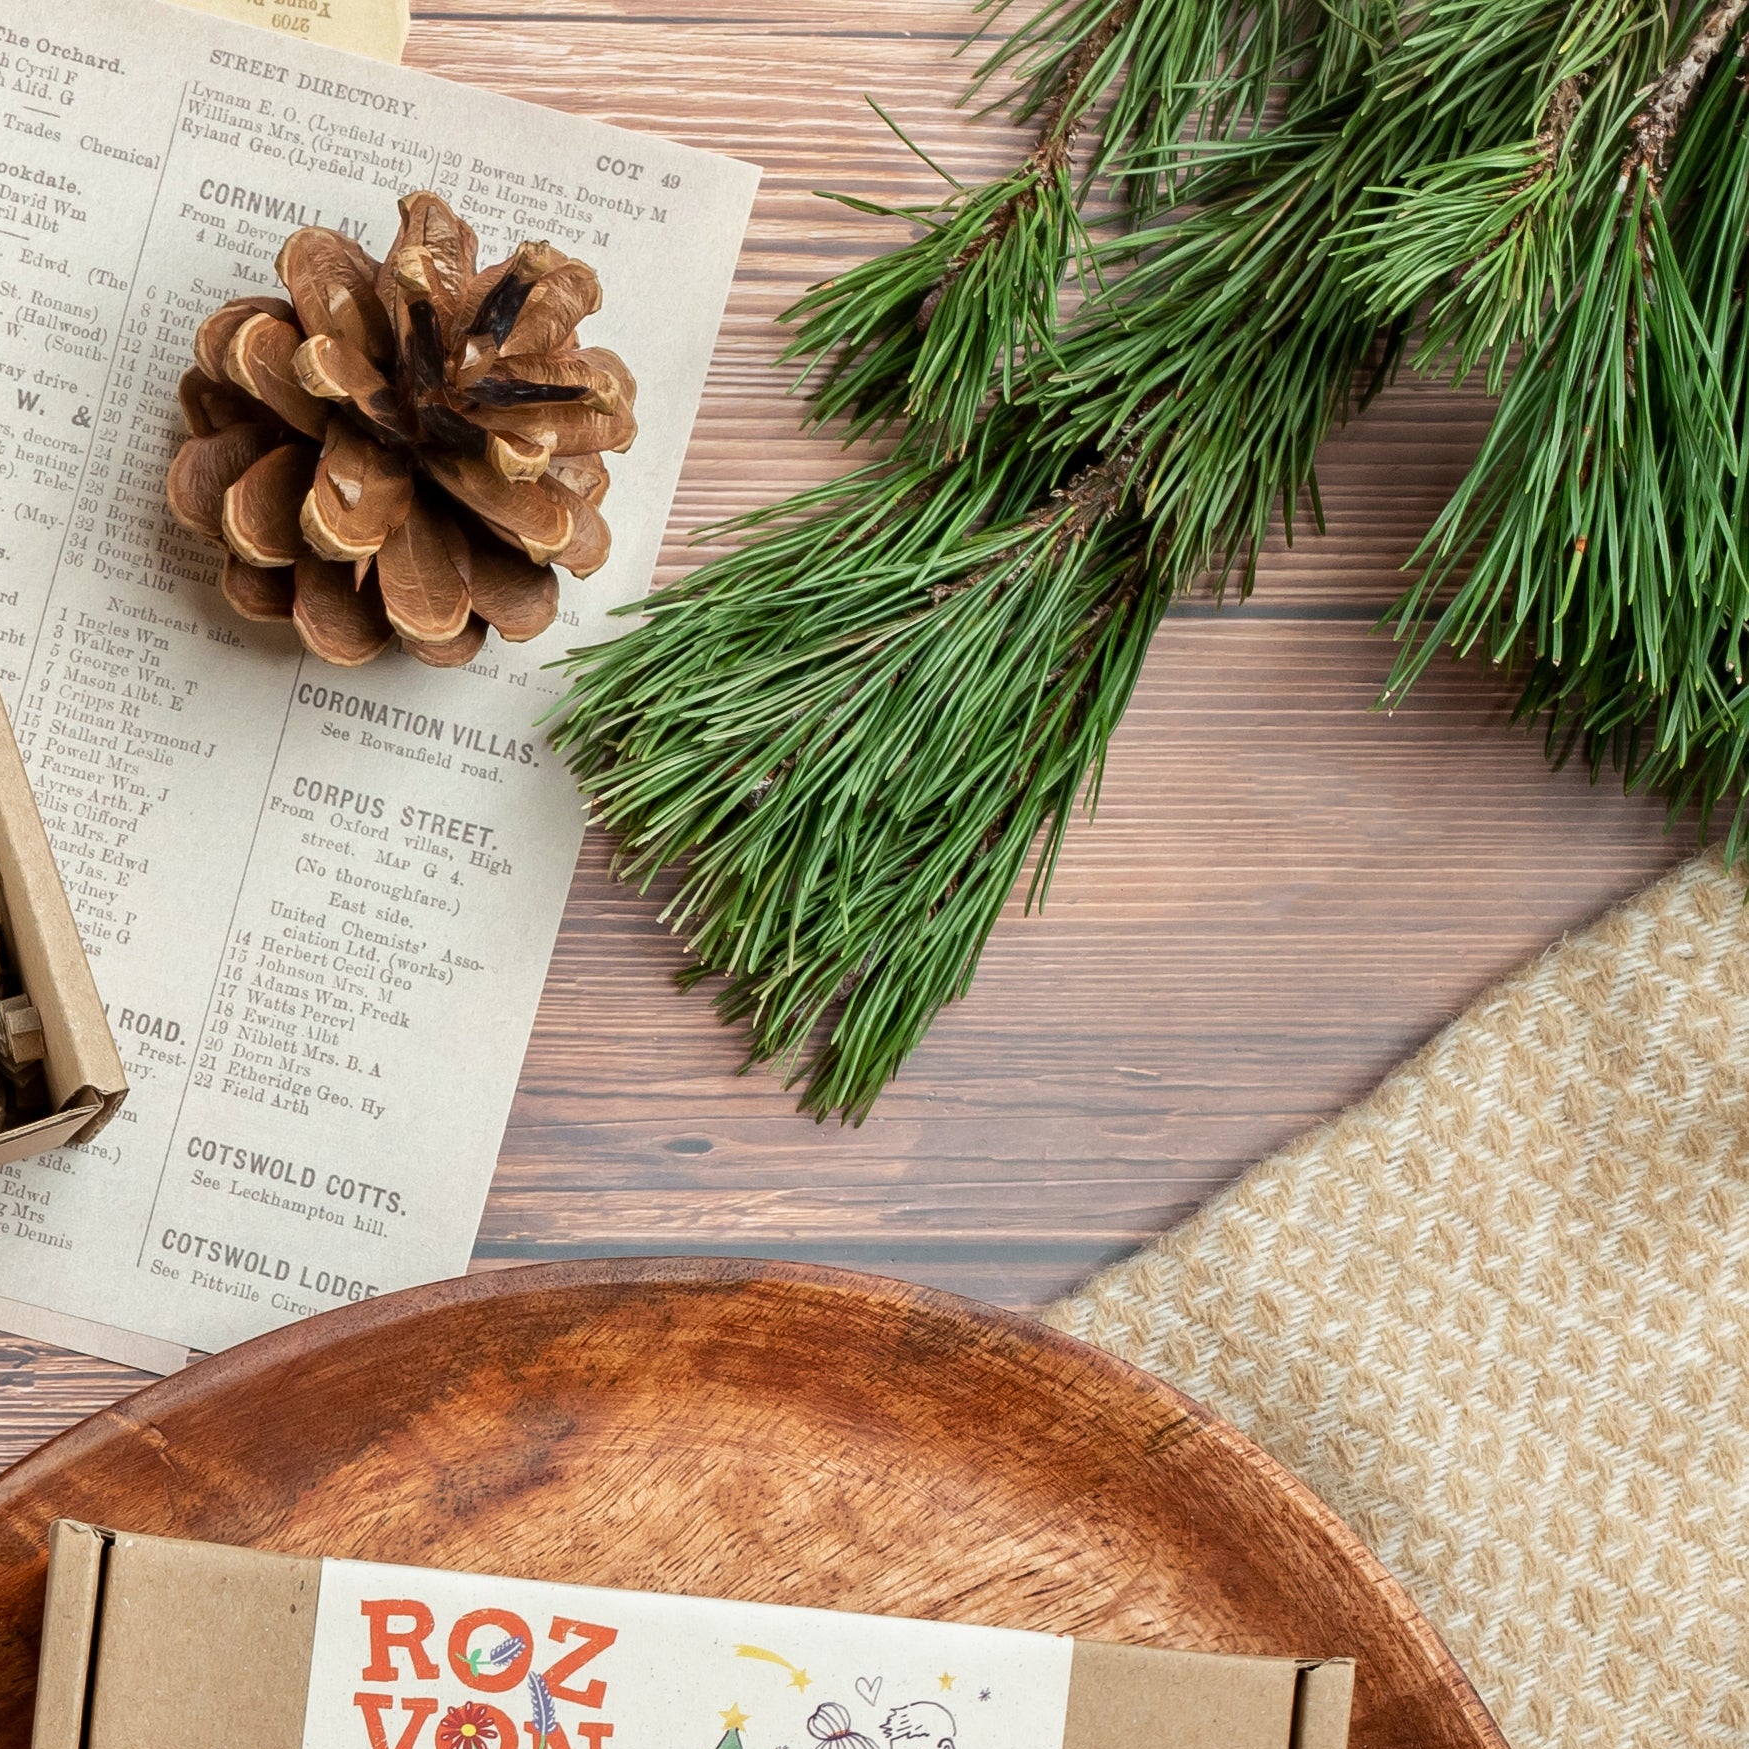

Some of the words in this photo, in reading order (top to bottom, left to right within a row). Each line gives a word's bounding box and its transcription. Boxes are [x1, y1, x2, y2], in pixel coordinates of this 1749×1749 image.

[14, 56, 60, 83] Cyril
[35, 37, 126, 76] Orchard.
[208, 48, 290, 84] STREET
[295, 71, 418, 121] DIRECTORY.
[2, 111, 62, 143] Trades
[78, 134, 161, 171] Chemical
[187, 97, 264, 134] Williams
[266, 121, 305, 146] Mrs.
[310, 133, 412, 178] (Grayshott)
[190, 79, 251, 111] Lynam
[307, 112, 386, 148] (Lyefield
[389, 137, 435, 165] villa)
[468, 156, 525, 187] Bowen
[529, 173, 568, 199] Mrs.
[573, 185, 646, 222] Dorothy
[595, 154, 645, 181] COT
[659, 172, 681, 190] 49
[19, 209, 60, 234] Albt
[53, 198, 87, 223] Wm
[458, 193, 507, 220] Storr
[511, 207, 586, 245] Geoffrey
[465, 175, 490, 196] De
[553, 199, 593, 224] Miss
[86, 266, 129, 292] (The
[14, 304, 108, 347] (Hallwood)
[29, 288, 99, 325] Ronans)
[5, 320, 28, 342] W.
[43, 332, 109, 363] (South-
[16, 387, 45, 416] W.
[70, 404, 92, 429] &
[22, 426, 85, 455] decora-
[32, 467, 75, 492] Tele-
[96, 539, 154, 570] Gough
[156, 555, 219, 588] Ronald
[75, 610, 130, 640] Ingles
[135, 626, 169, 652] Wm
[105, 594, 199, 636] North-east
[205, 625, 246, 649] side.
[68, 646, 130, 679] George
[136, 664, 176, 691] Wm.
[47, 717, 119, 751] Stallard
[122, 738, 174, 767] Leslie
[52, 699, 116, 731] Pitman
[119, 718, 202, 755] Raymond
[297, 682, 445, 741] CORONATION
[452, 722, 540, 768] VILLAS.
[43, 735, 102, 765] Powell
[104, 753, 140, 776] Mrs
[319, 720, 351, 742] See
[357, 729, 453, 770] Rowanfield
[459, 761, 504, 784] road.
[268, 794, 315, 822] From
[328, 811, 390, 842] Oxford
[403, 834, 454, 862] villas,
[467, 849, 513, 876] High
[292, 775, 385, 819] CORPUS
[399, 804, 498, 851] STREET.
[299, 831, 355, 857] street.
[422, 861, 439, 879] G
[449, 869, 464, 887] 4.
[294, 854, 327, 878] (No
[334, 866, 461, 918] thoroughfare.)
[326, 890, 366, 916] East
[374, 906, 414, 930] side.
[269, 898, 327, 930] United
[438, 947, 485, 972] Asso-
[281, 924, 340, 952] ciation
[344, 939, 381, 964] Ltd.
[381, 951, 454, 986] (works)
[259, 934, 328, 968] Herbert
[331, 955, 376, 981] Cecil
[378, 967, 413, 991] Geo
[246, 986, 297, 1017] Watts
[249, 971, 309, 1001] Adams
[314, 987, 354, 1013] Wm.
[358, 1000, 411, 1029] Fredk
[117, 1007, 186, 1046] ROAD.
[235, 1023, 298, 1055] Niblett
[300, 1042, 340, 1067] Mrs.
[136, 1040, 187, 1067] Prest-
[219, 1077, 266, 1104] Field
[269, 1092, 309, 1117] Arth
[224, 1059, 312, 1097] Etheridge
[315, 1084, 354, 1109] Geo.
[359, 1096, 387, 1121] Hy
[186, 1135, 316, 1189] COTSWOLD
[324, 1173, 406, 1217] COTTS.
[189, 1168, 221, 1191] See
[227, 1178, 345, 1227] Leckhampton
[351, 1213, 388, 1239] hill.
[13, 1220, 73, 1251] Dennis
[160, 1227, 291, 1281] COTSWOLD
[149, 1257, 180, 1280] See
[188, 1268, 260, 1303] Pittville
[361, 1598, 619, 1710] ROZ
